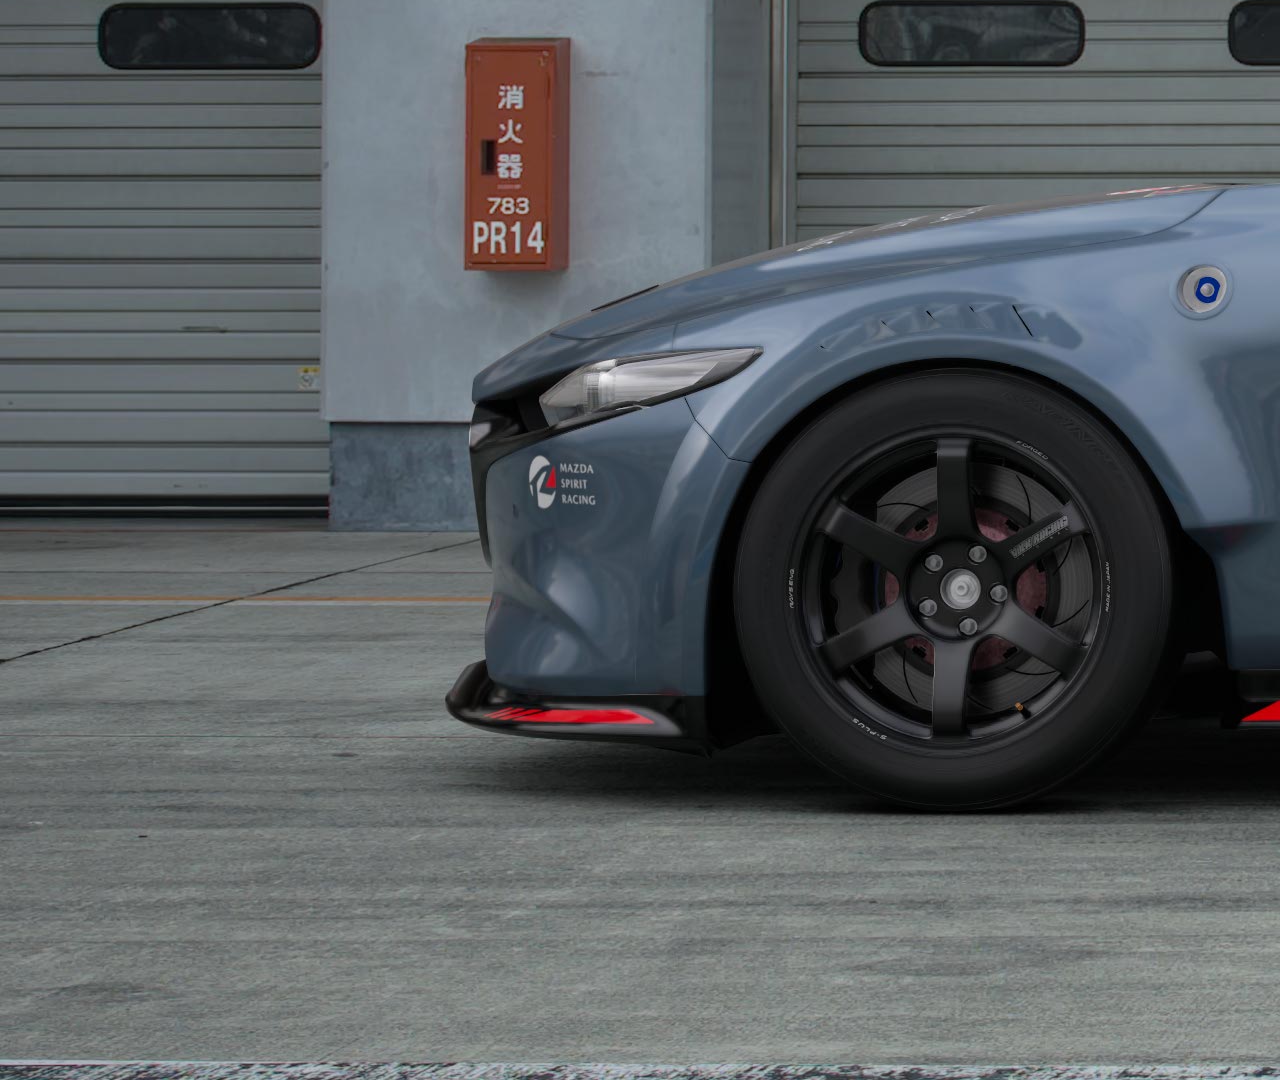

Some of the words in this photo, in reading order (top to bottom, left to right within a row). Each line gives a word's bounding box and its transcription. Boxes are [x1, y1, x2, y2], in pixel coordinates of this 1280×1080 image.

[497, 84, 525, 179] 消火器
[487, 197, 530, 215] 783
[472, 221, 545, 254] PR14
[560, 463, 594, 474] MAZDA
[561, 478, 587, 489] SPIRIT
[562, 494, 596, 505] RACING
